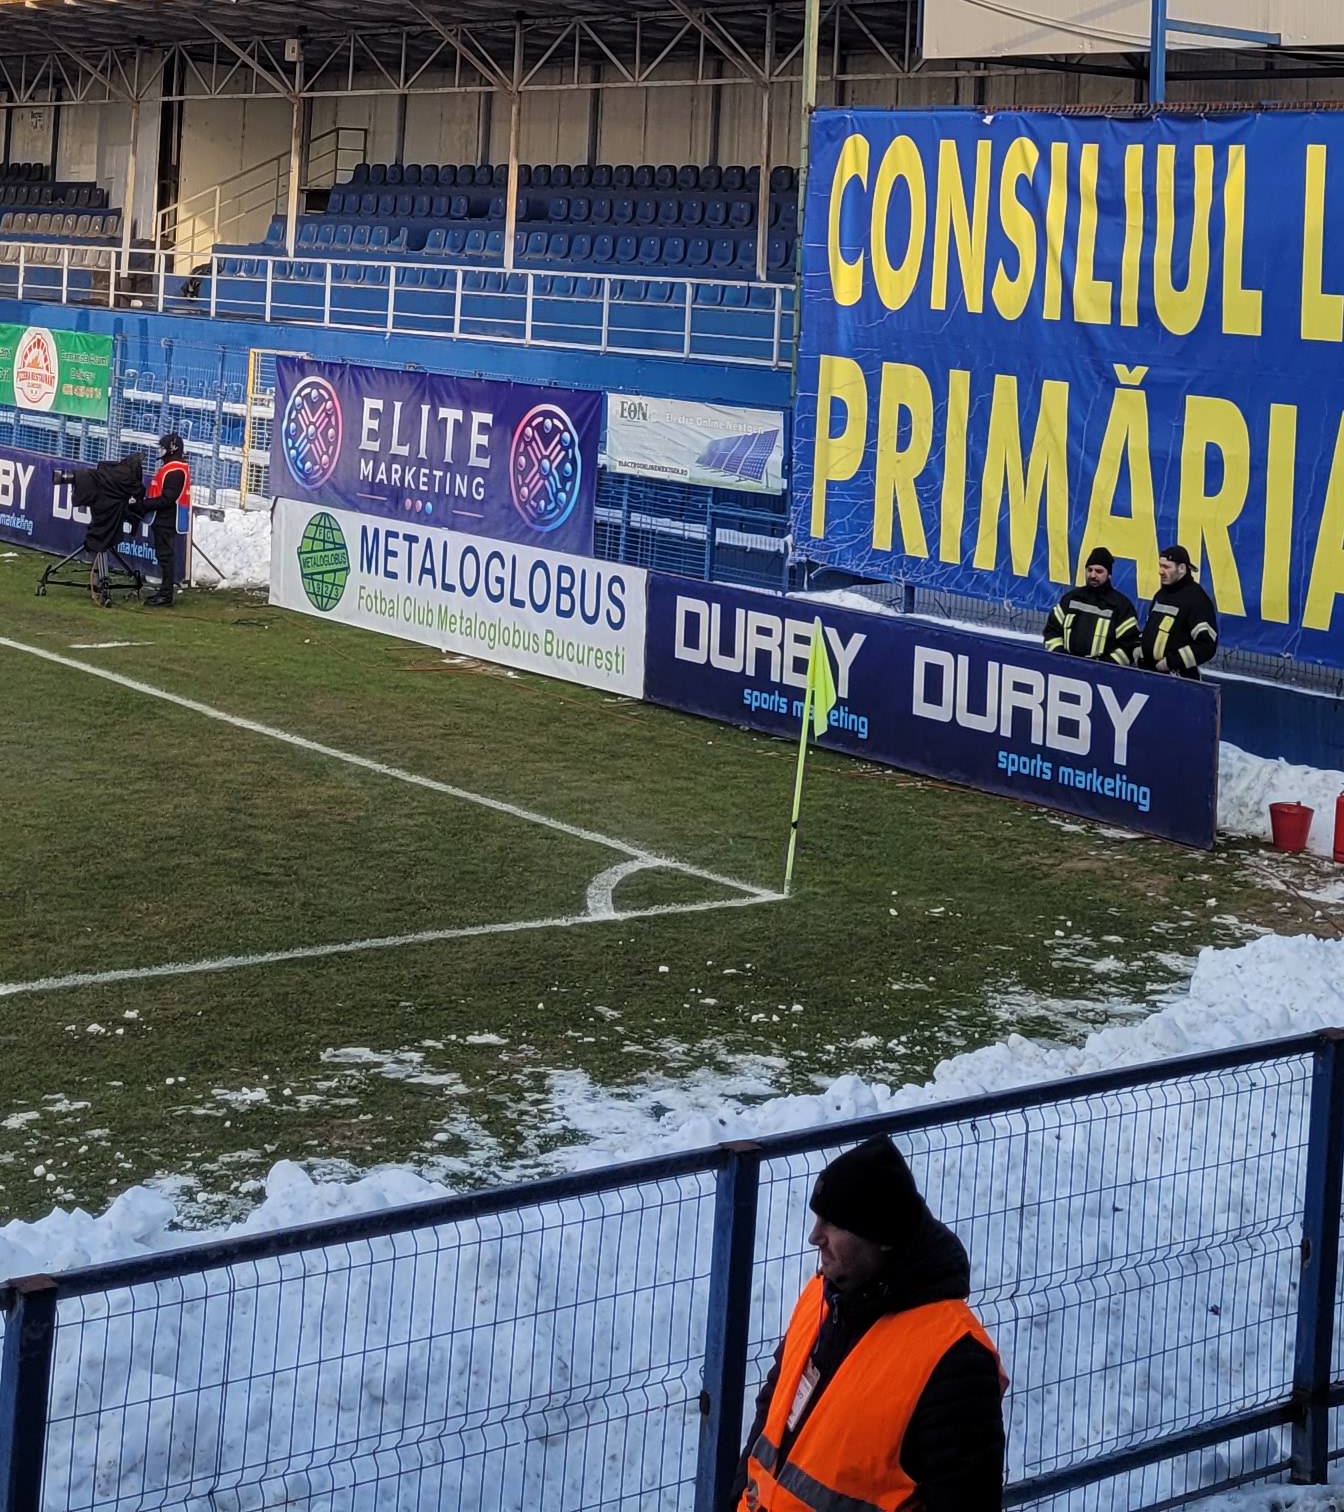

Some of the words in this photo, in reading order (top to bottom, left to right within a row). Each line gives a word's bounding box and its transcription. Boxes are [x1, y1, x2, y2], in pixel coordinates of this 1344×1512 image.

[827, 133, 1263, 337] CONSILIUL
[358, 396, 494, 469] ELITE
[665, 412, 694, 426] Electro
[697, 416, 725, 430] Online
[726, 420, 764, 436] Nextgen
[359, 458, 485, 501] MARKETING
[0, 512, 34, 536] marketing
[302, 552, 347, 569] METALOGLOBUS
[359, 524, 626, 631] METALOGLOBUS
[357, 585, 400, 618] Fotbal
[403, 594, 434, 628] Club
[437, 602, 540, 652] Metaloglobus
[544, 629, 625, 677] București
[674, 595, 867, 699] DURBY
[743, 688, 787, 714] sports
[912, 645, 1150, 766] DURBY
[997, 750, 1053, 781] sports
[1058, 765, 1150, 812] marketing
